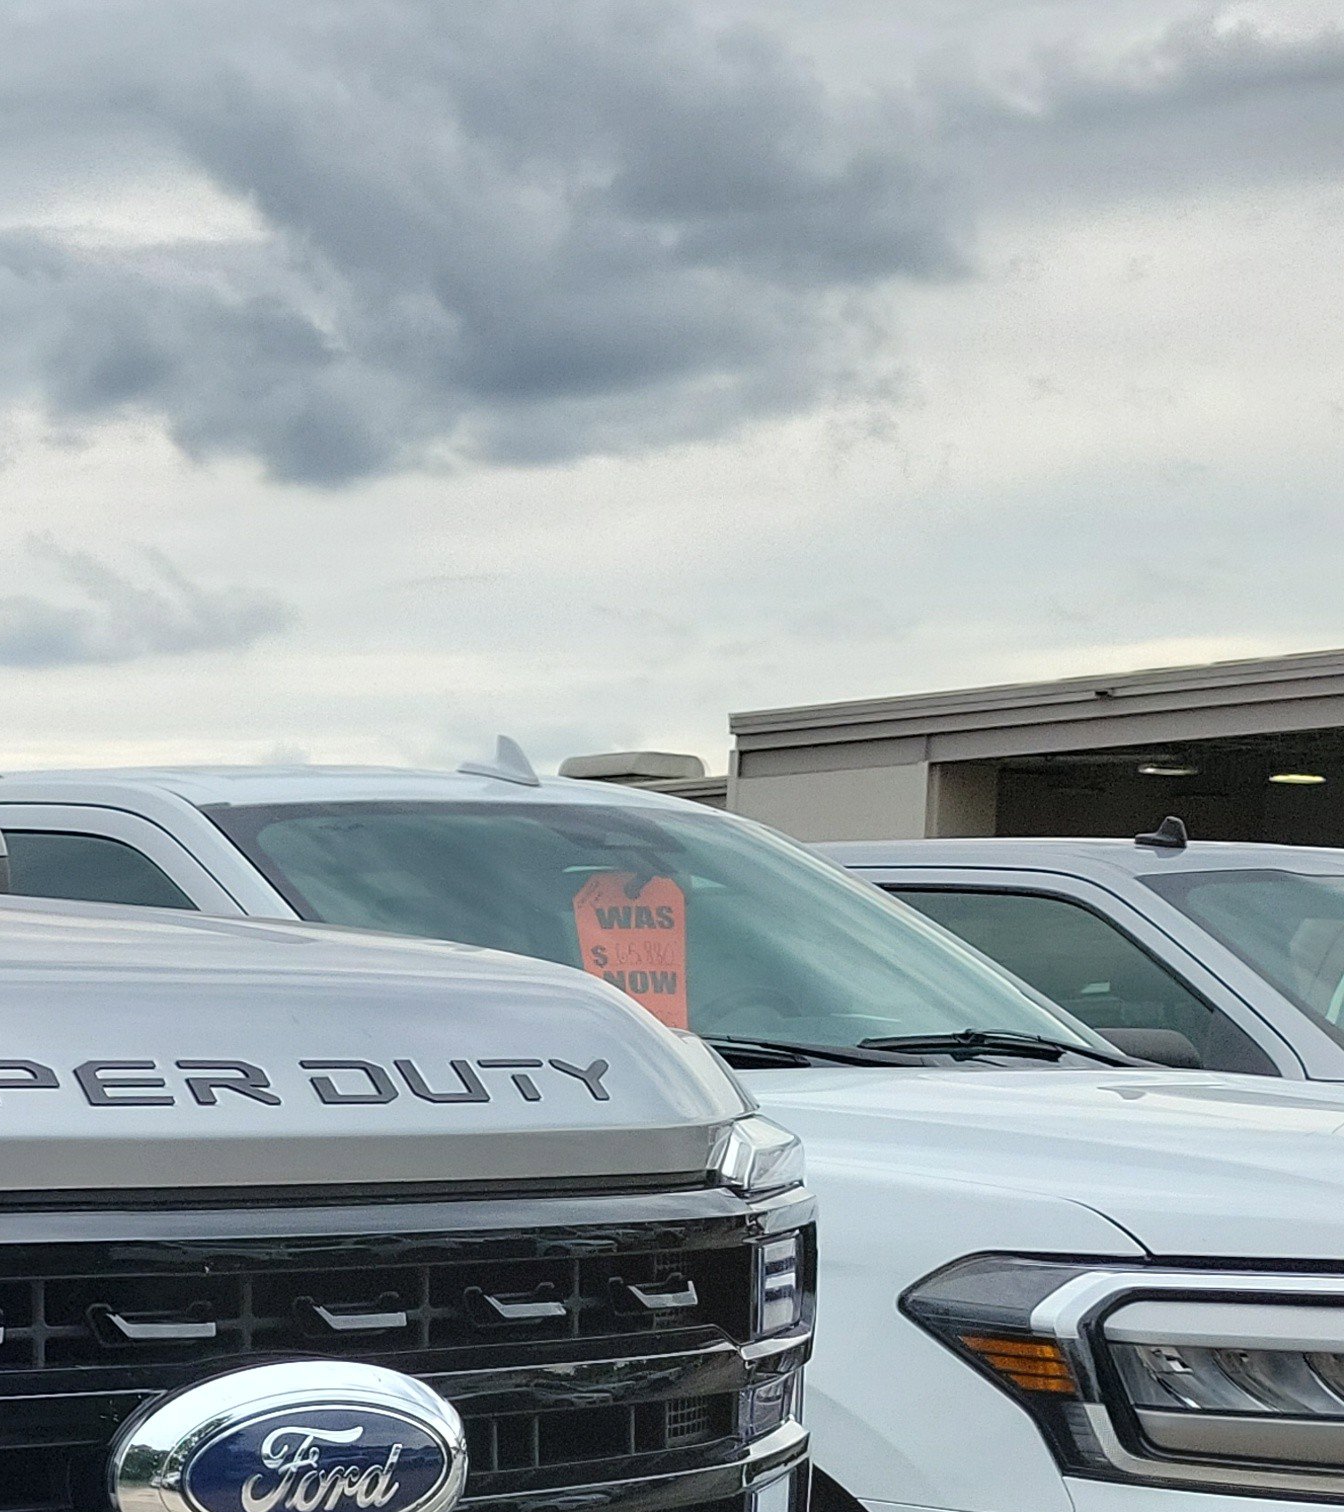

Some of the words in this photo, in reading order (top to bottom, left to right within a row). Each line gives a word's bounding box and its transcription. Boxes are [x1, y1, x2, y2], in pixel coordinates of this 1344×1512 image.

[595, 905, 676, 930] WAS
[603, 970, 677, 995] NOW
[298, 1056, 611, 1105] DUTY
